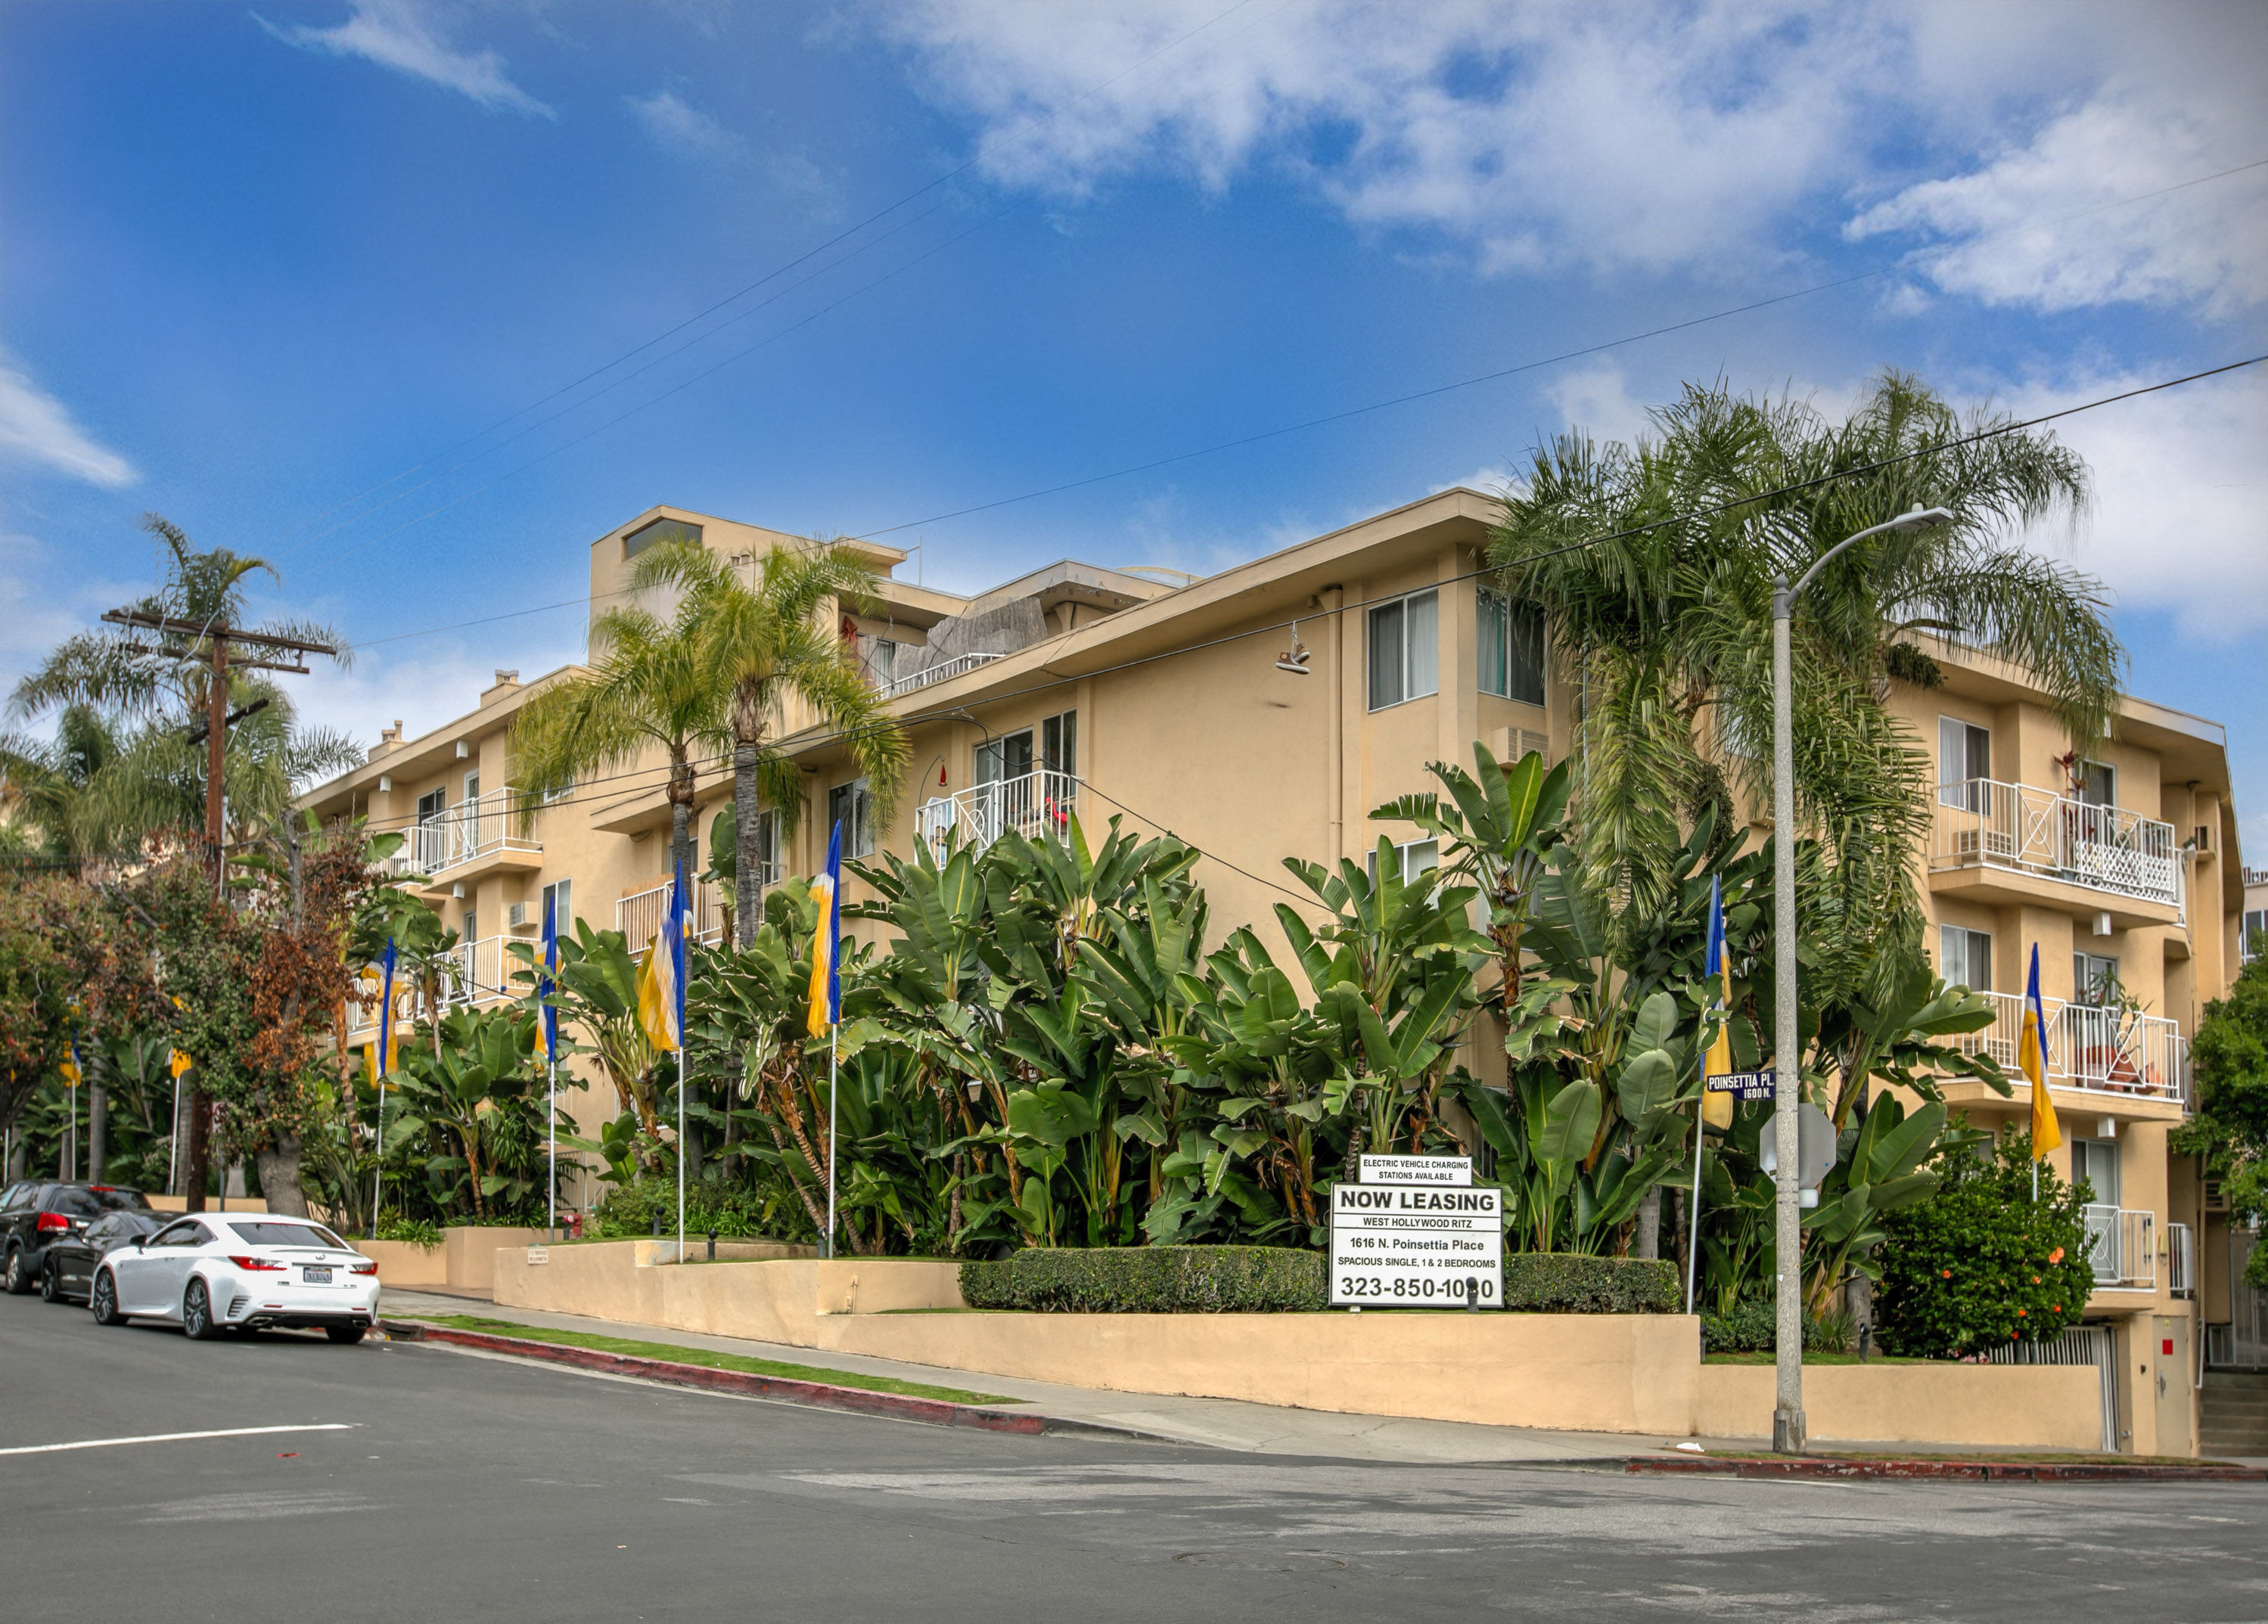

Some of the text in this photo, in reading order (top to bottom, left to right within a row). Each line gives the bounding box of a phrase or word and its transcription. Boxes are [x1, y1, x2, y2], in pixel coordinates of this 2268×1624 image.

[1709, 1073, 1775, 1090] POINSETTIA PL.
[1744, 1088, 1771, 1098] 1600 N.
[1431, 1161, 1468, 1169] CHARGING
[1341, 1191, 1494, 1211] NOW LEASING
[1363, 1217, 1472, 1228] WEST HOLLYWOOD RITZ
[1350, 1237, 1484, 1250] 1616 N. Poinsettia Place
[1338, 1257, 1382, 1265] SPACIOUS
[1385, 1259, 1419, 1268] SINGLE,
[1445, 1259, 1496, 1268] BEDROOMS
[1341, 1277, 1493, 1299] 323-850-100
